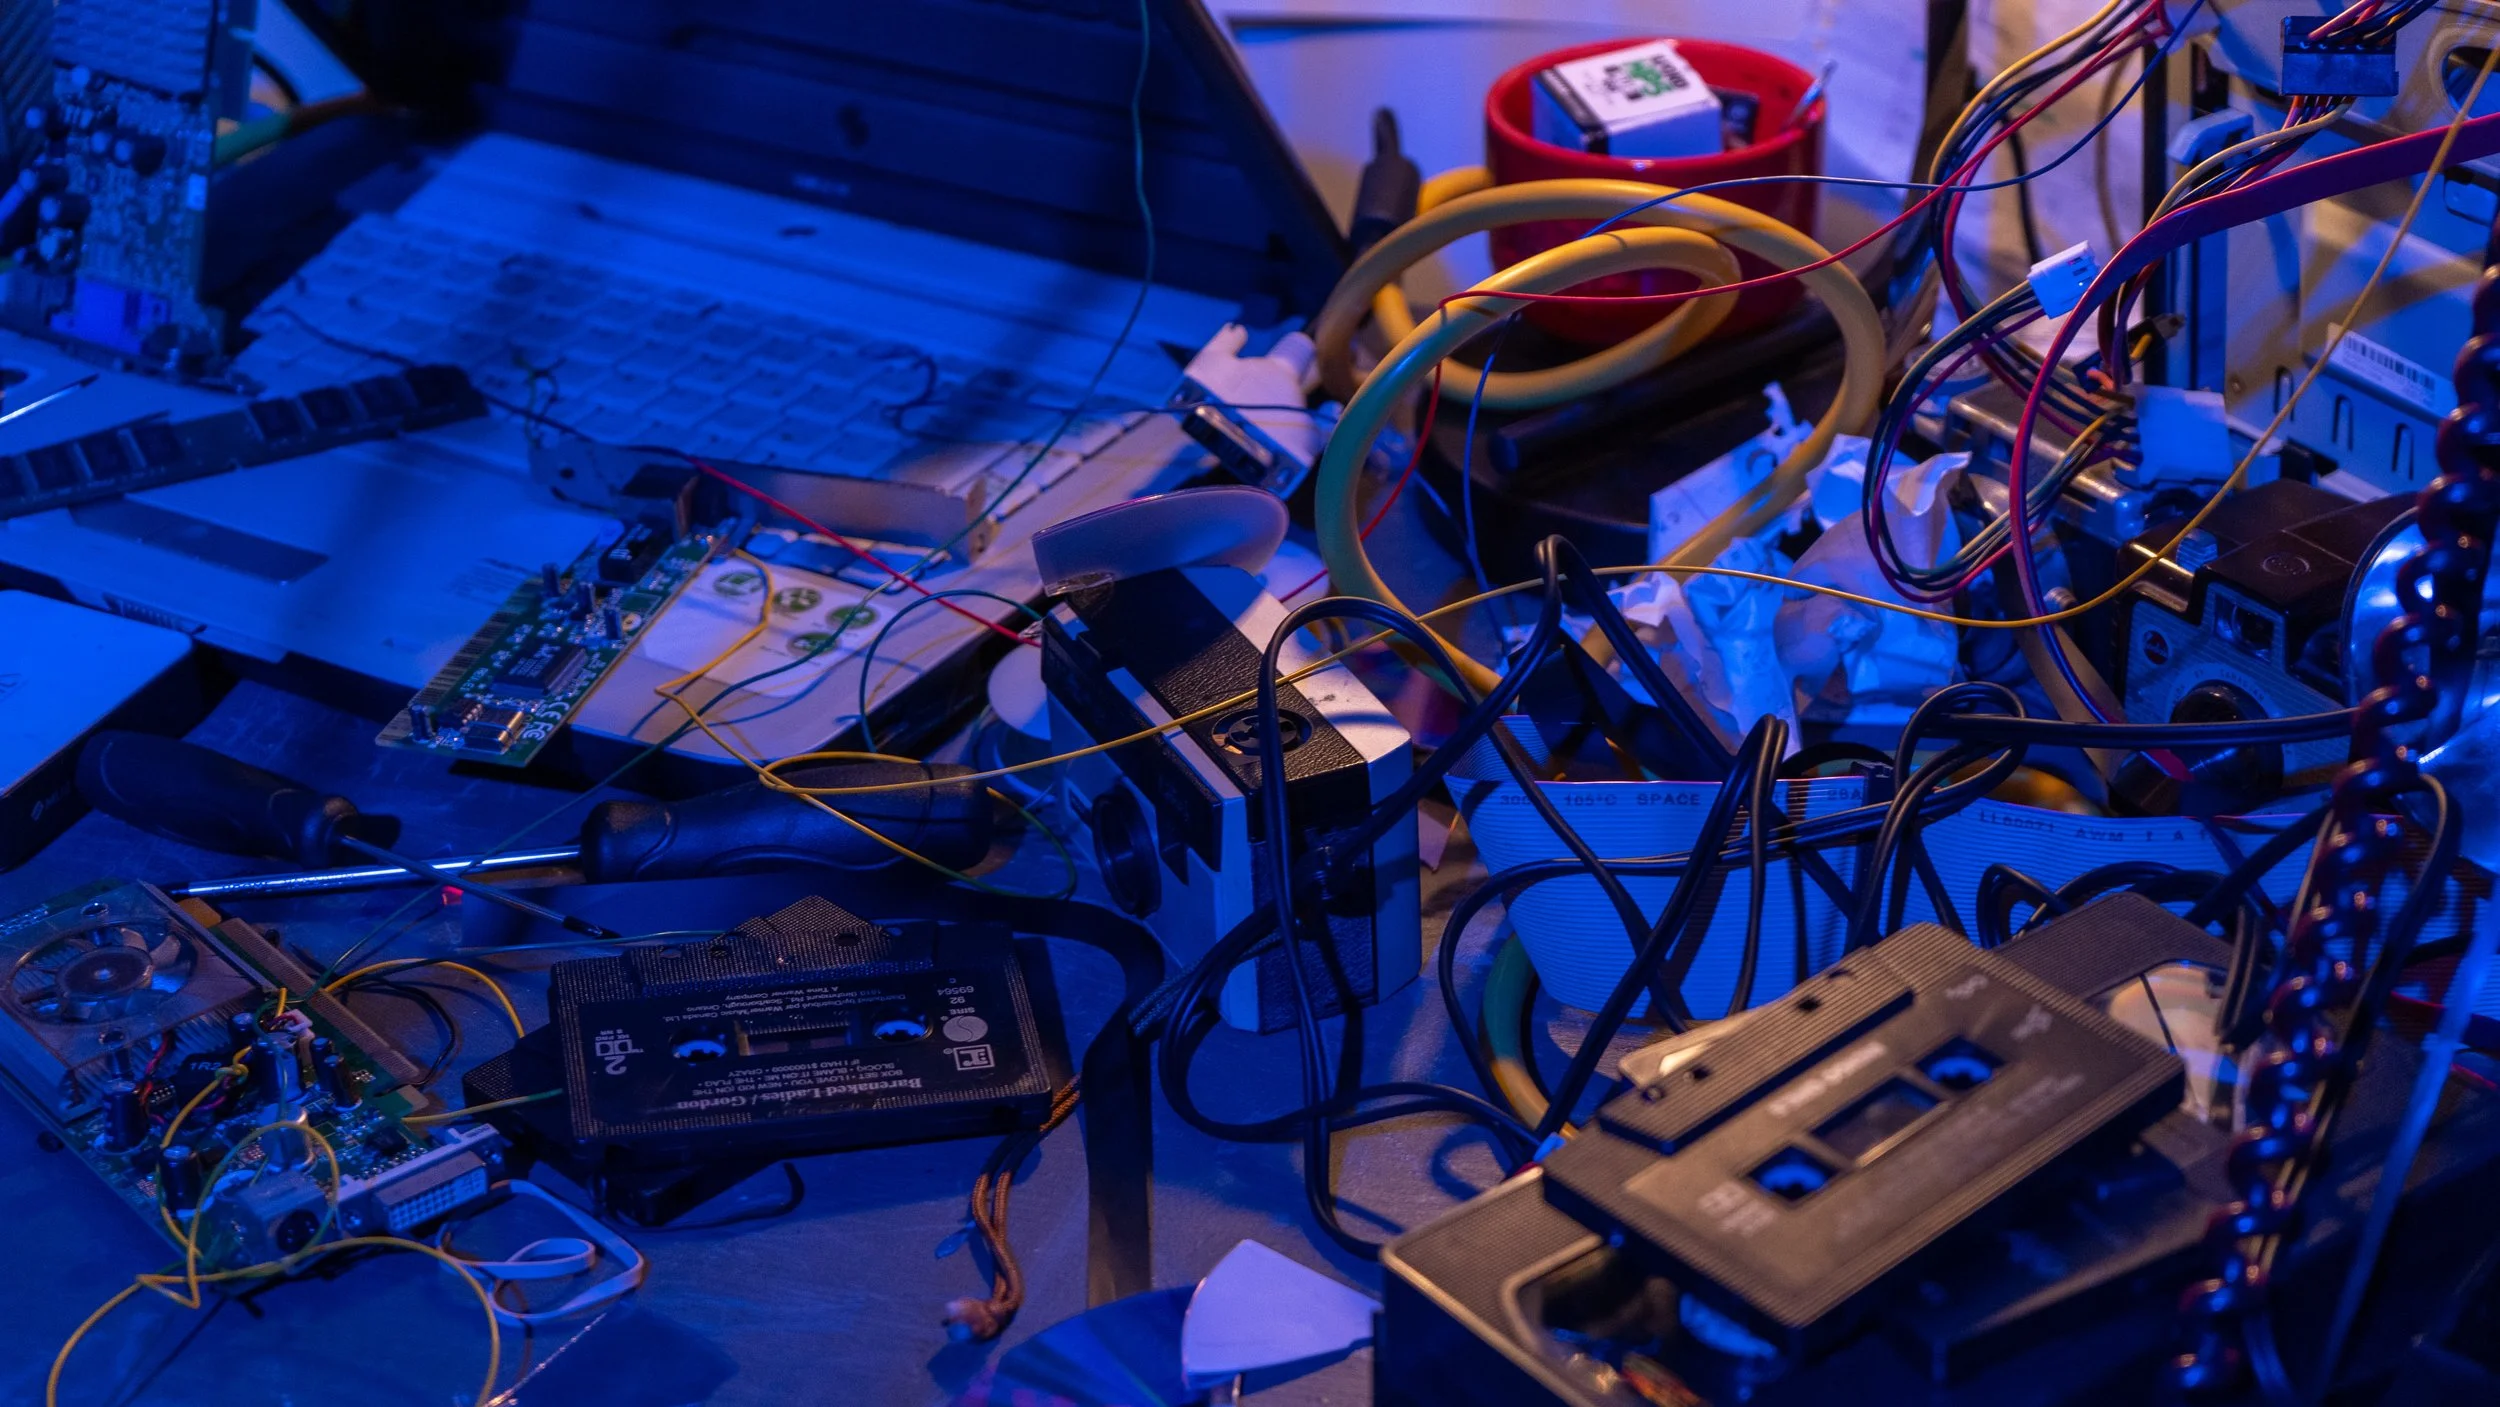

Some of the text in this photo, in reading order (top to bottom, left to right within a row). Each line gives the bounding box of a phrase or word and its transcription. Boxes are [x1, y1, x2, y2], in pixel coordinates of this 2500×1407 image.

[1636, 793, 1701, 806] SPACE
[724, 992, 769, 1002] Company
[770, 989, 805, 998] Warner
[857, 993, 906, 1005] Distributed
[949, 995, 966, 1005] 92
[685, 1004, 720, 1013] Ontario
[750, 1005, 783, 1013] Warner
[784, 1001, 801, 1011] par
[948, 1006, 976, 1016] SIRE
[681, 1011, 719, 1021] Canada
[720, 1008, 749, 1016] Music
[604, 1055, 627, 1075] 2
[820, 1060, 842, 1069] HAD
[728, 1068, 763, 1078] CRAZY
[781, 1072, 799, 1080] ON
[811, 1067, 848, 1077] BLAME
[881, 1069, 903, 1077] BOX
[733, 1077, 755, 1086] THE
[763, 1074, 780, 1082] ME
[815, 1074, 844, 1084] LOVE
[703, 1079, 732, 1088] FLAG
[757, 1082, 782, 1090] NEW
[825, 1077, 922, 1097] Barenaked
[691, 1088, 713, 1097] THE
[759, 1087, 821, 1103] Ladies
[676, 1095, 747, 1110] Gordon
